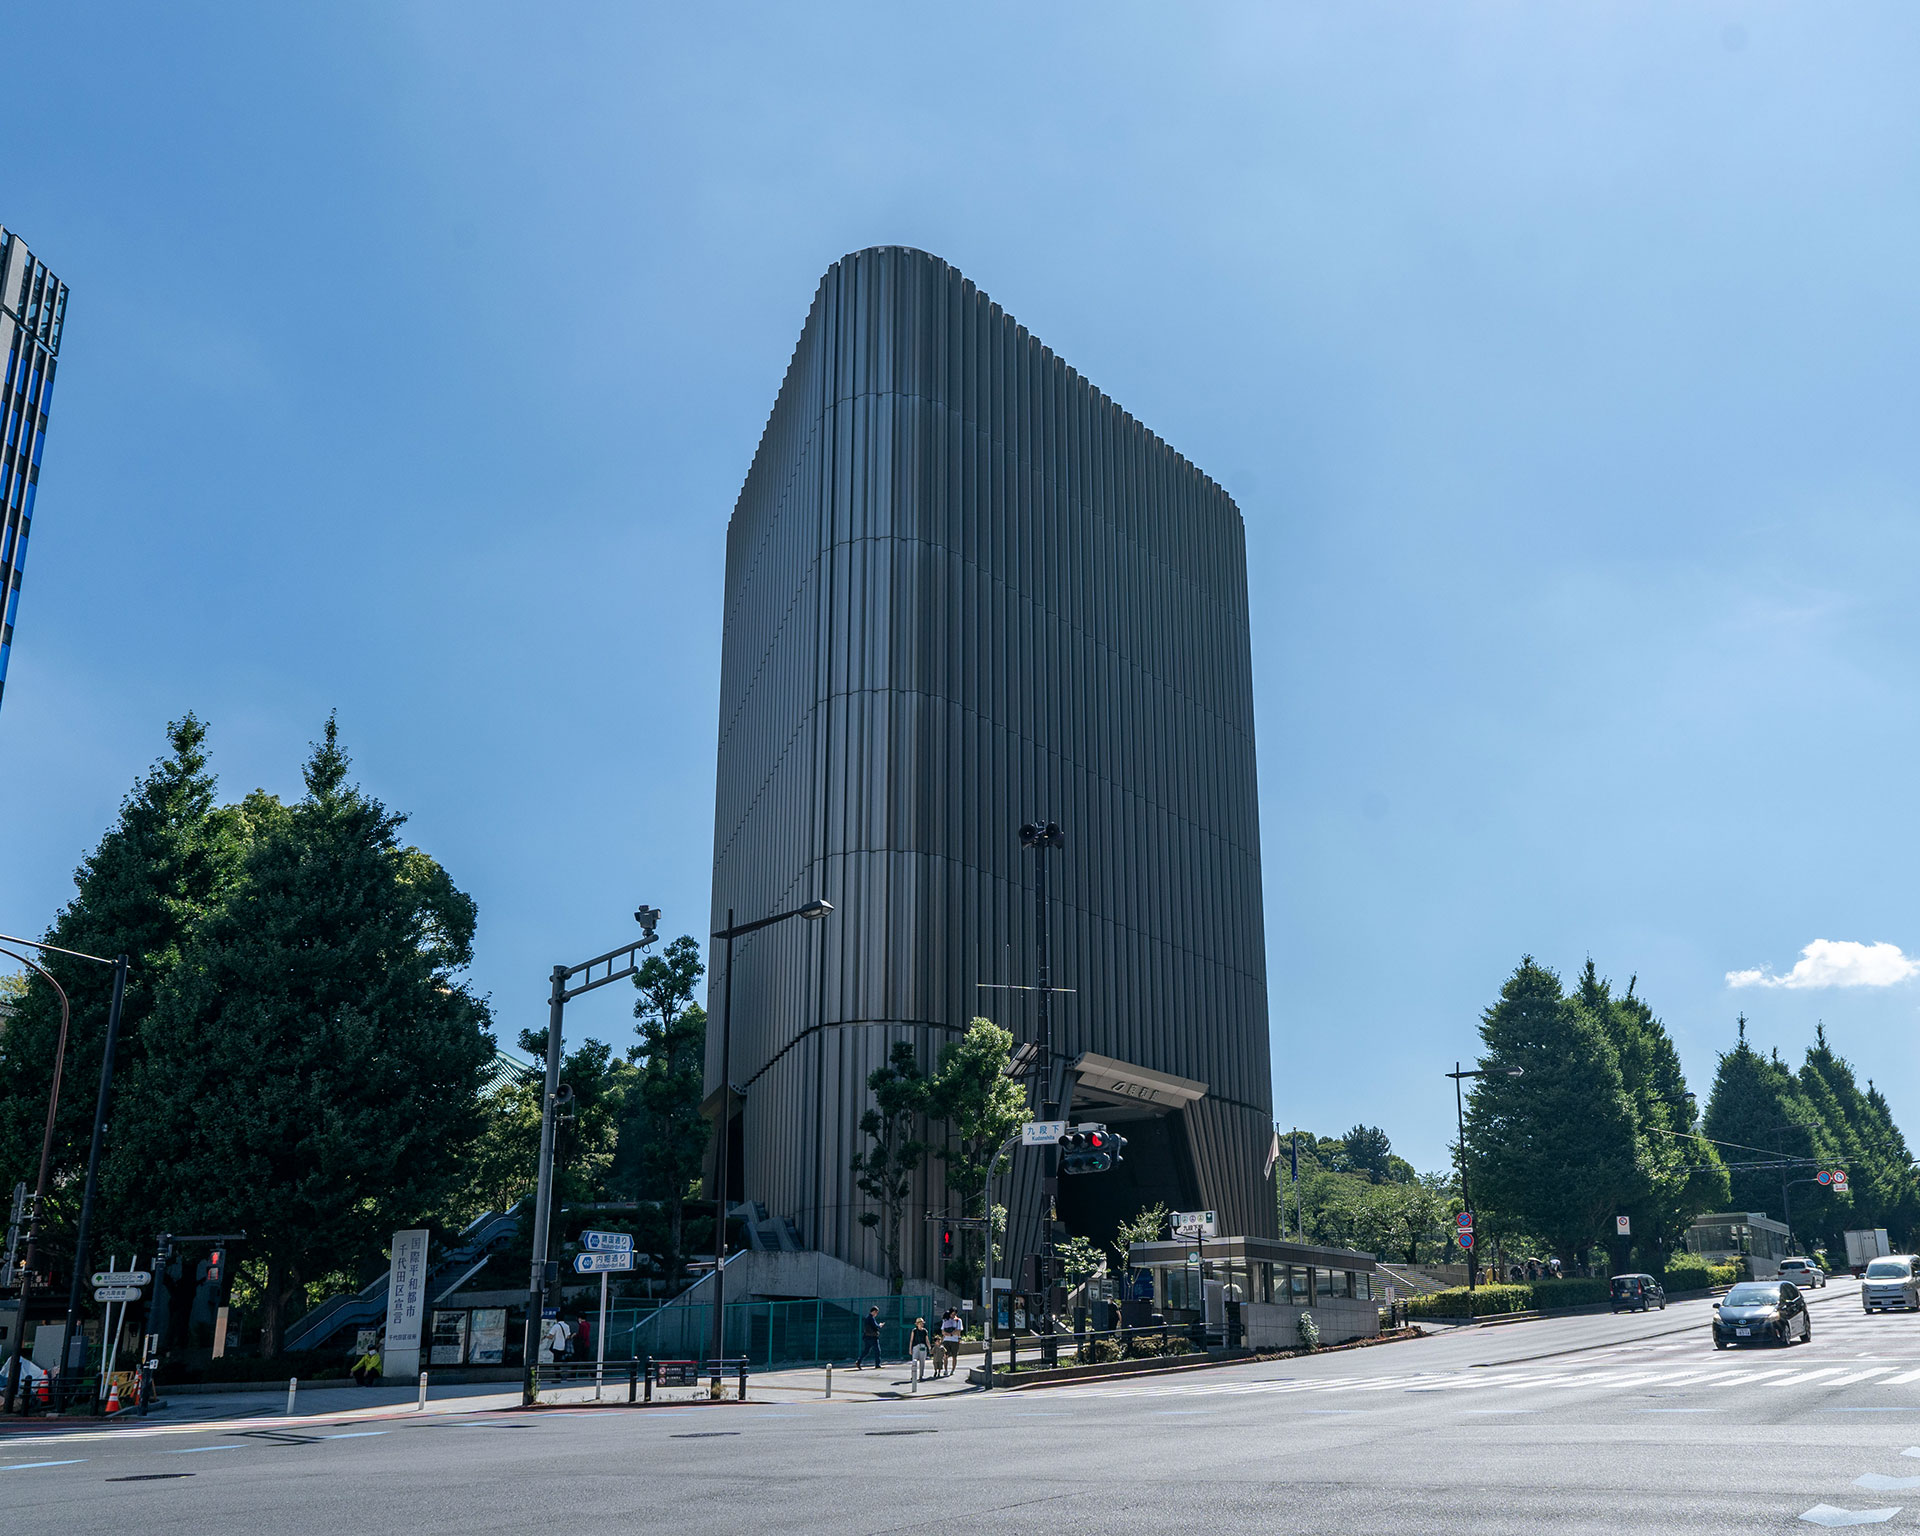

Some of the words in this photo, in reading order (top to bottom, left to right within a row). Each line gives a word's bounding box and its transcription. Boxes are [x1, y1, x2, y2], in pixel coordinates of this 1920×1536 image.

[1027, 1124, 1060, 1136] 九段下
[406, 1237, 421, 1318] 国際平和都市
[596, 1254, 626, 1263] 内堀通り
[393, 1243, 408, 1324] 千代田区宣言
